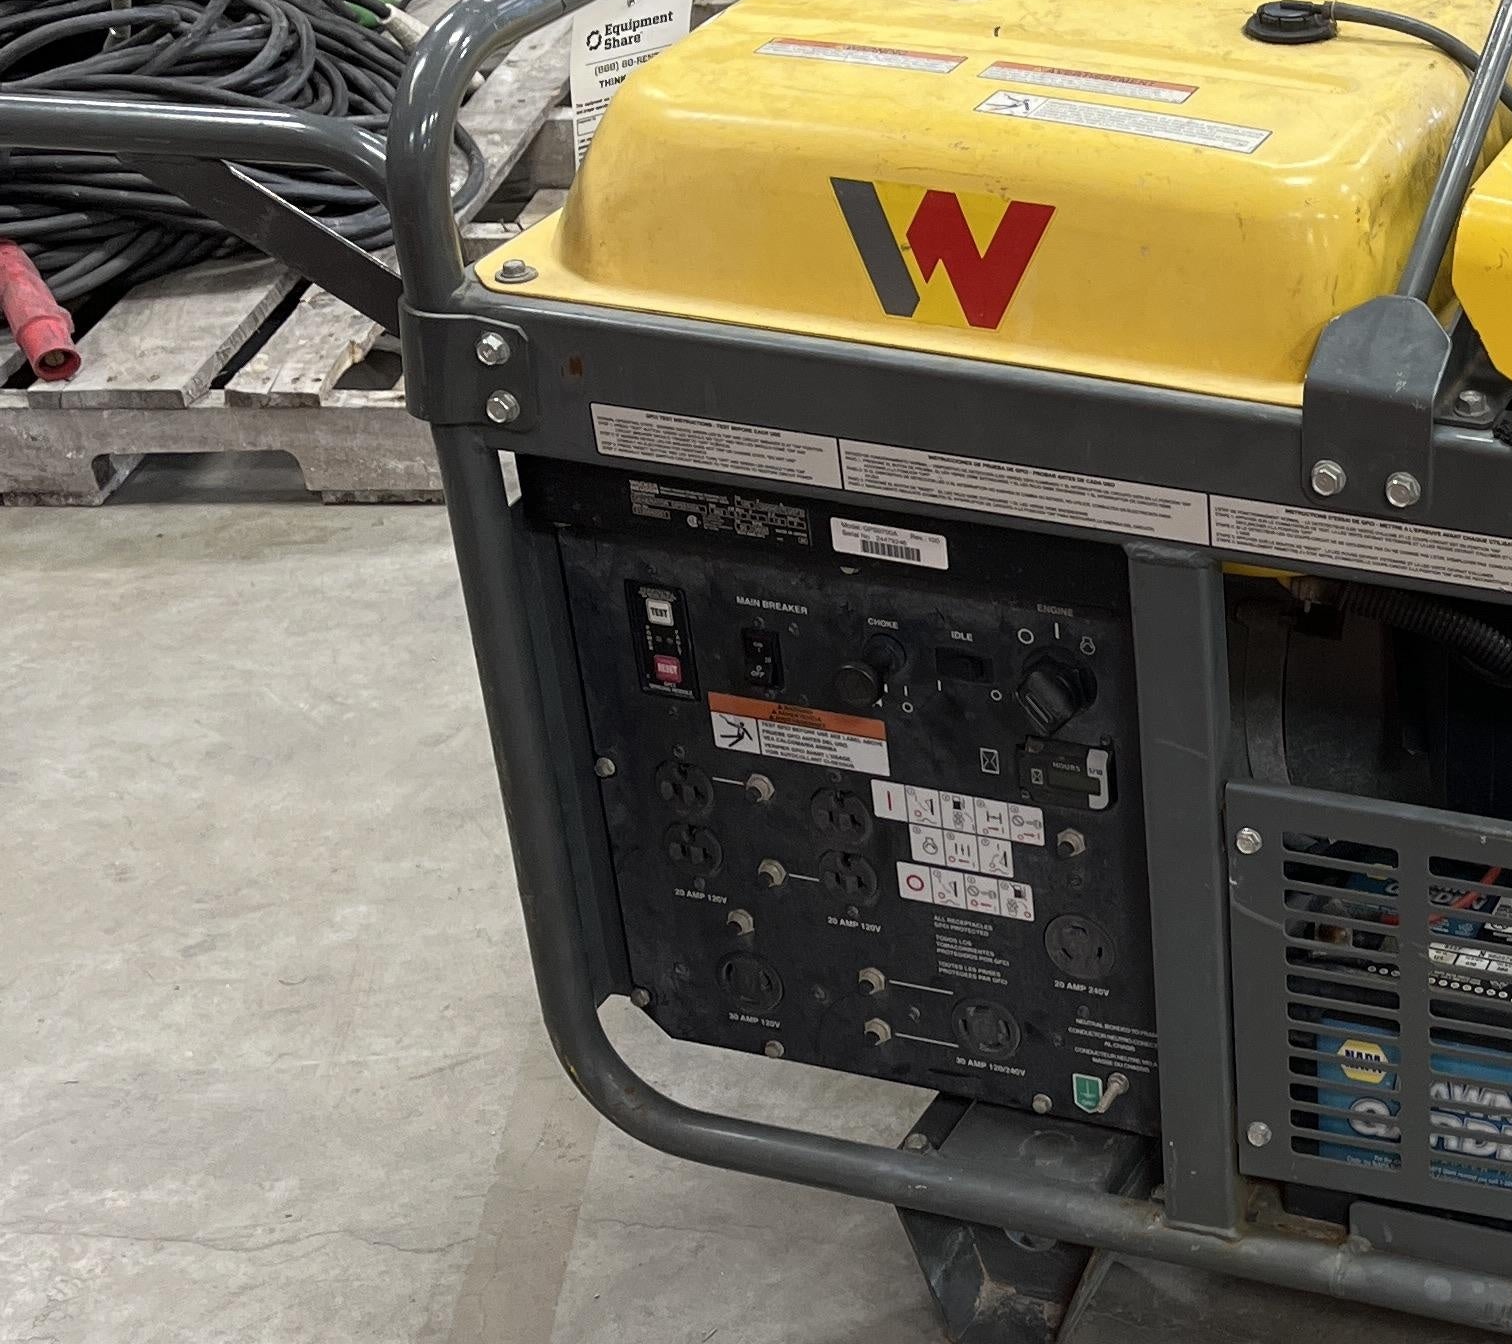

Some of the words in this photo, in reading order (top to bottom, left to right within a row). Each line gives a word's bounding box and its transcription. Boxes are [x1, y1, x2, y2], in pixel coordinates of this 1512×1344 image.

[604, 11, 674, 36] Equipment
[604, 33, 641, 50] Share
[650, 607, 668, 618] TEST
[736, 595, 760, 608] MAIN
[762, 599, 808, 616] BREAKER
[1036, 603, 1074, 617] ENGINE
[867, 617, 899, 630] CHOKE
[951, 630, 973, 642] IDLE
[657, 662, 678, 674] RESET
[1052, 761, 1081, 772] HOURS
[674, 887, 685, 897] 20
[686, 890, 706, 901] AMP
[707, 894, 727, 905] 120V
[839, 918, 859, 928] AMP
[861, 921, 882, 933] 120V
[1054, 980, 1064, 989] 20
[1066, 981, 1086, 991] AMP
[1088, 986, 1110, 997] 240V
[740, 1015, 759, 1024] AMP
[761, 1018, 780, 1029] 120V
[968, 1059, 987, 1069] AMP
